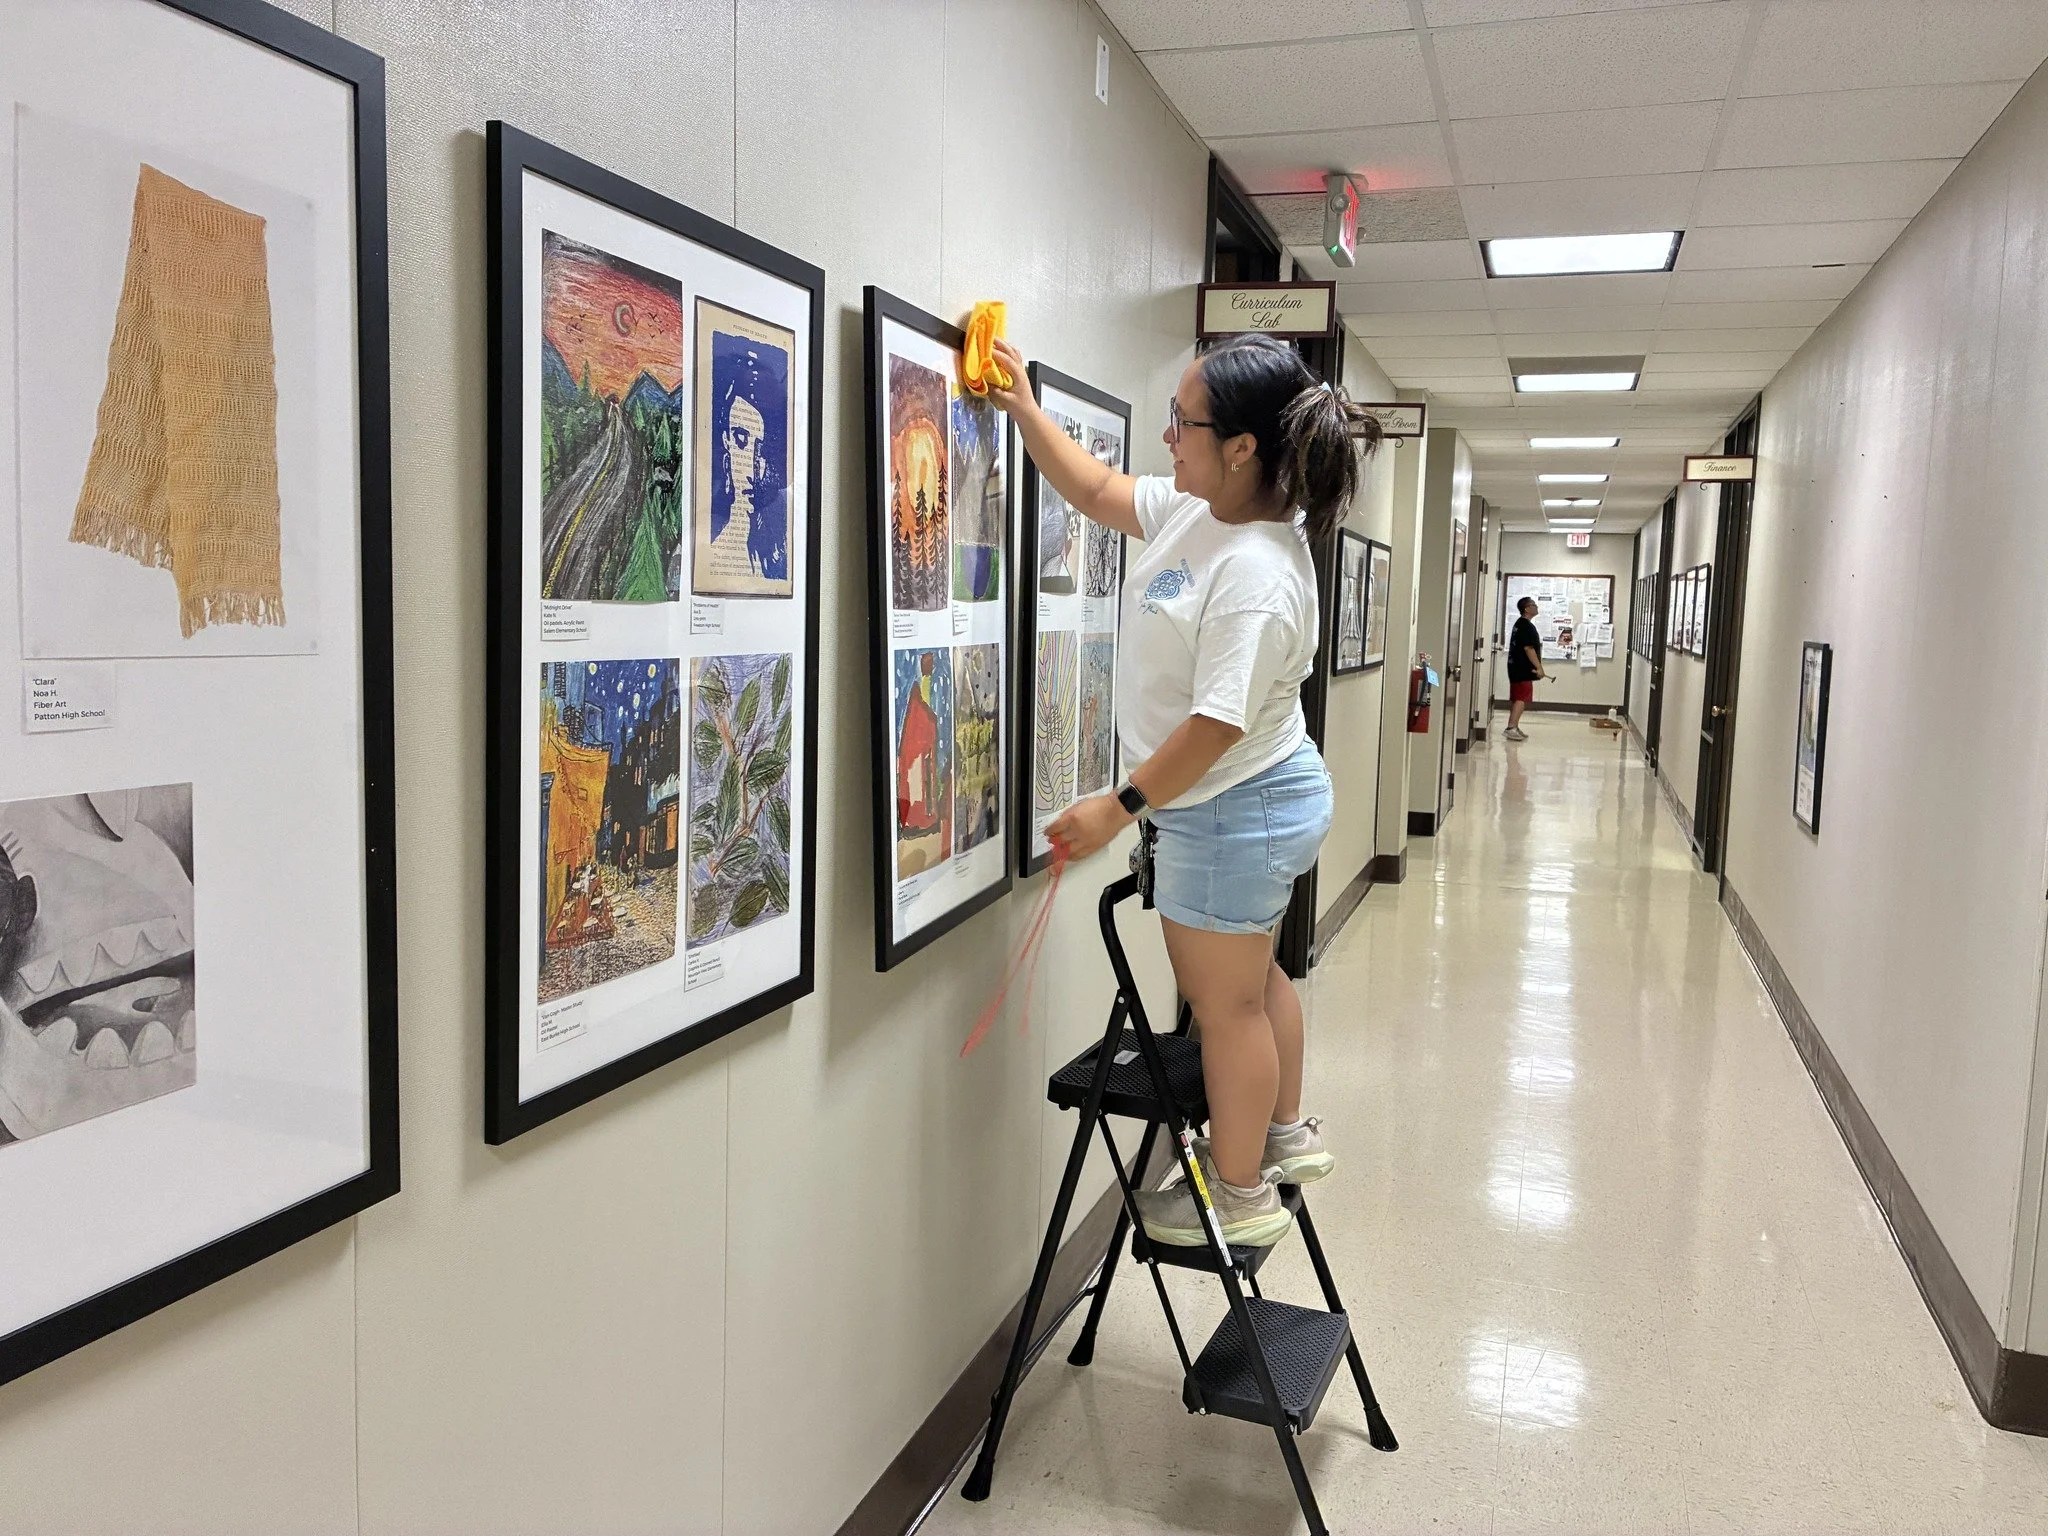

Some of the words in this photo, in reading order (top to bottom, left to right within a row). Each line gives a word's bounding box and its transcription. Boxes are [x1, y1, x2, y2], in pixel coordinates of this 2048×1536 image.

[1231, 292, 1303, 310] Curriculum
[1249, 311, 1283, 329] Lab
[1390, 416, 1418, 429] Room
[1703, 461, 1737, 473] Finance
[1571, 534, 1588, 546] EXIT
[33, 690, 49, 698] Noa
[33, 701, 53, 709] Fiber
[34, 713, 60, 721] Patton
[61, 711, 80, 720] High
